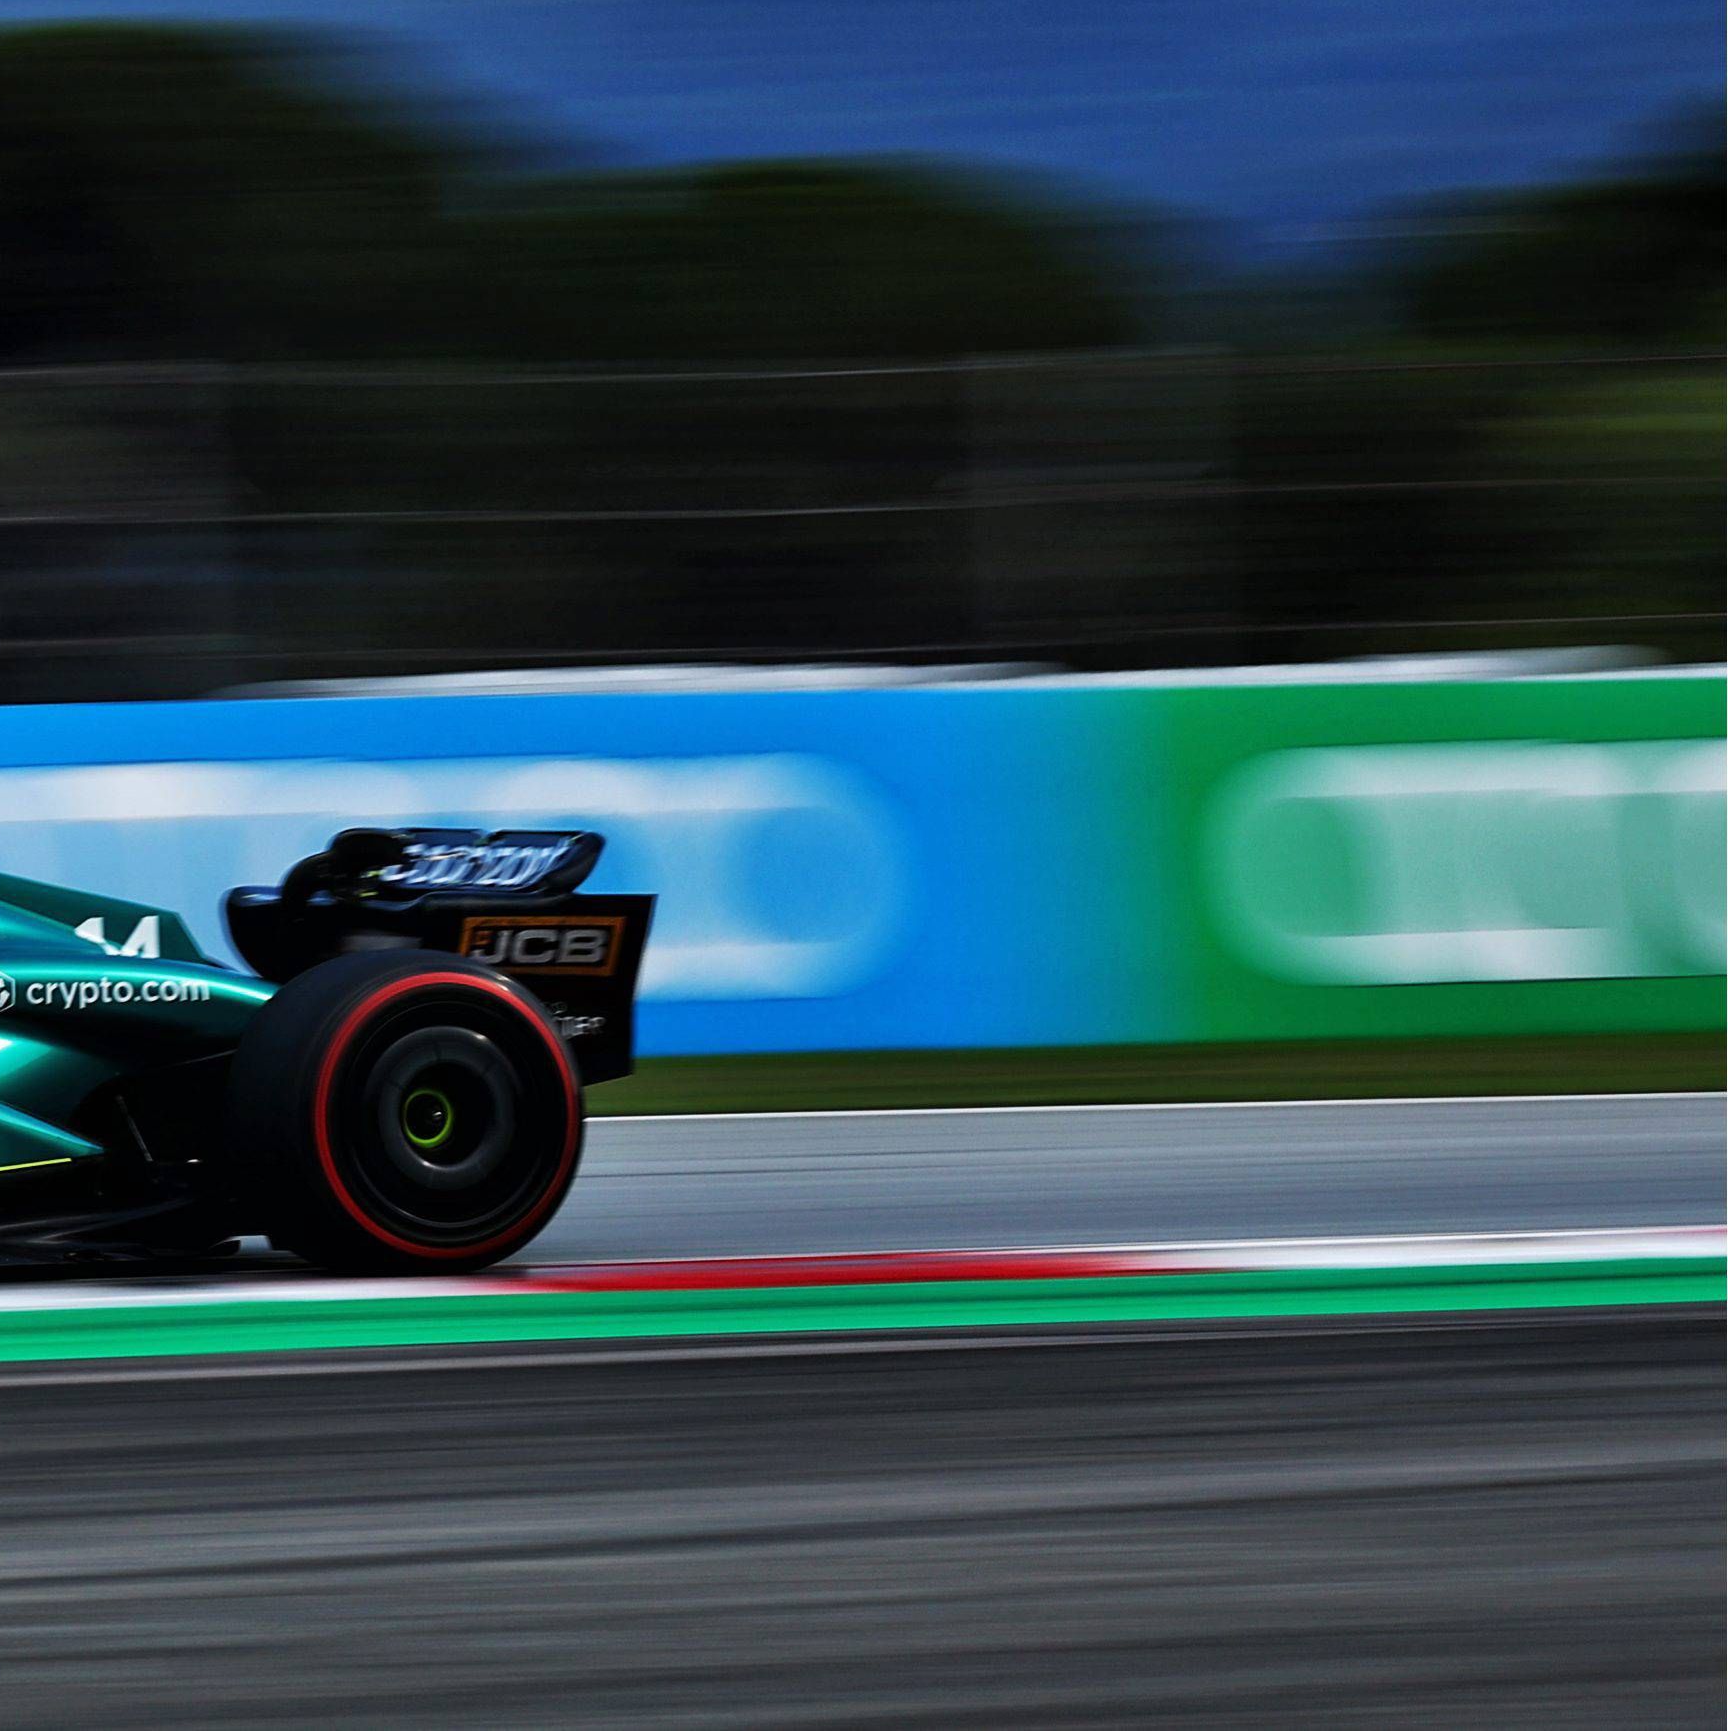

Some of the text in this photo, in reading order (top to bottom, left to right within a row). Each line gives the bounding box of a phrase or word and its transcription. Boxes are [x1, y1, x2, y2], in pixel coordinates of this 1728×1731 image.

[74, 915, 160, 959] 14
[472, 929, 609, 964] JCB
[26, 976, 210, 1010] crypto.com
